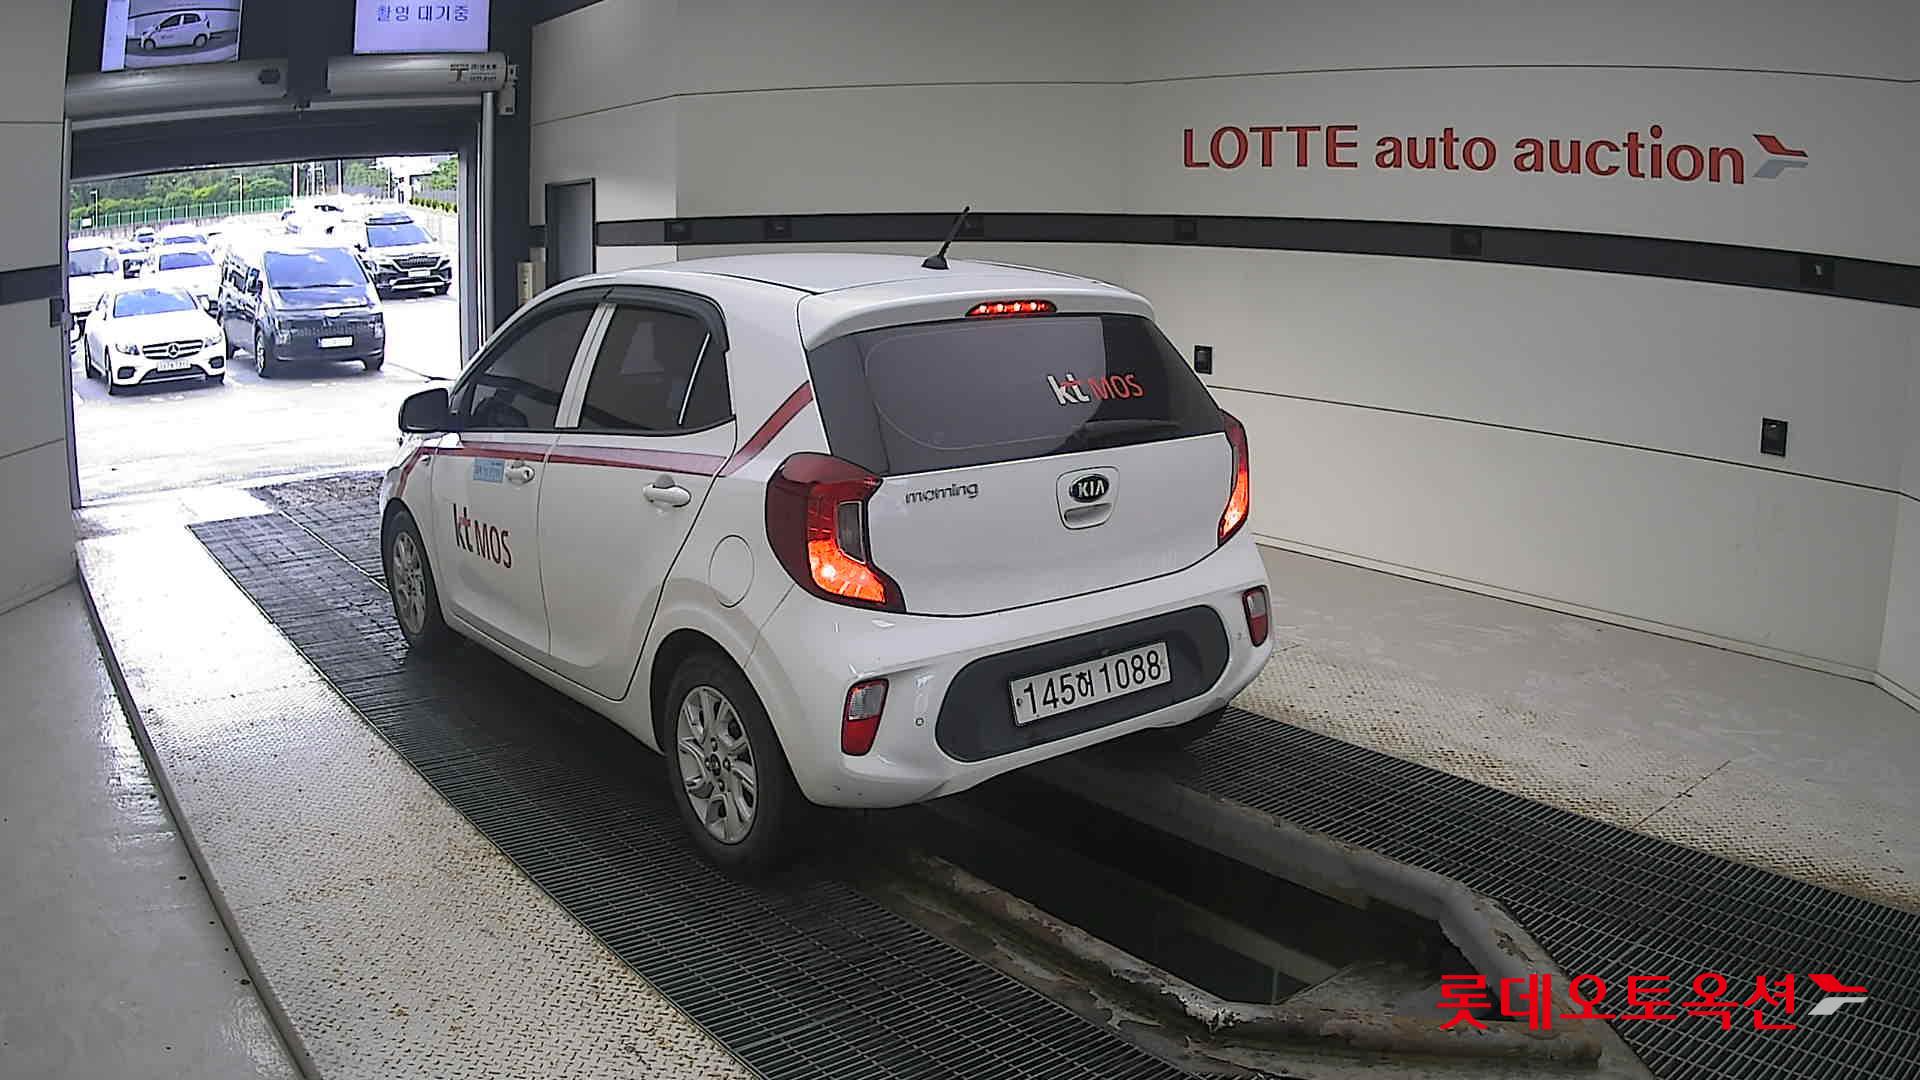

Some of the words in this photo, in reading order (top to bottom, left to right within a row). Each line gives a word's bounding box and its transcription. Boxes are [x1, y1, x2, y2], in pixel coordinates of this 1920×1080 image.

[418, 5, 469, 22] 대기중
[1183, 125, 1360, 170] LOTTE
[1375, 127, 1498, 172] auto
[1512, 125, 1745, 185] auction
[1047, 374, 1091, 405] kt
[1087, 374, 1145, 400] MOS
[1077, 480, 1106, 498] KIA
[453, 503, 474, 553] kt
[474, 519, 512, 569] MOS
[1023, 669, 1095, 715] 145허
[1099, 650, 1162, 693] 1088
